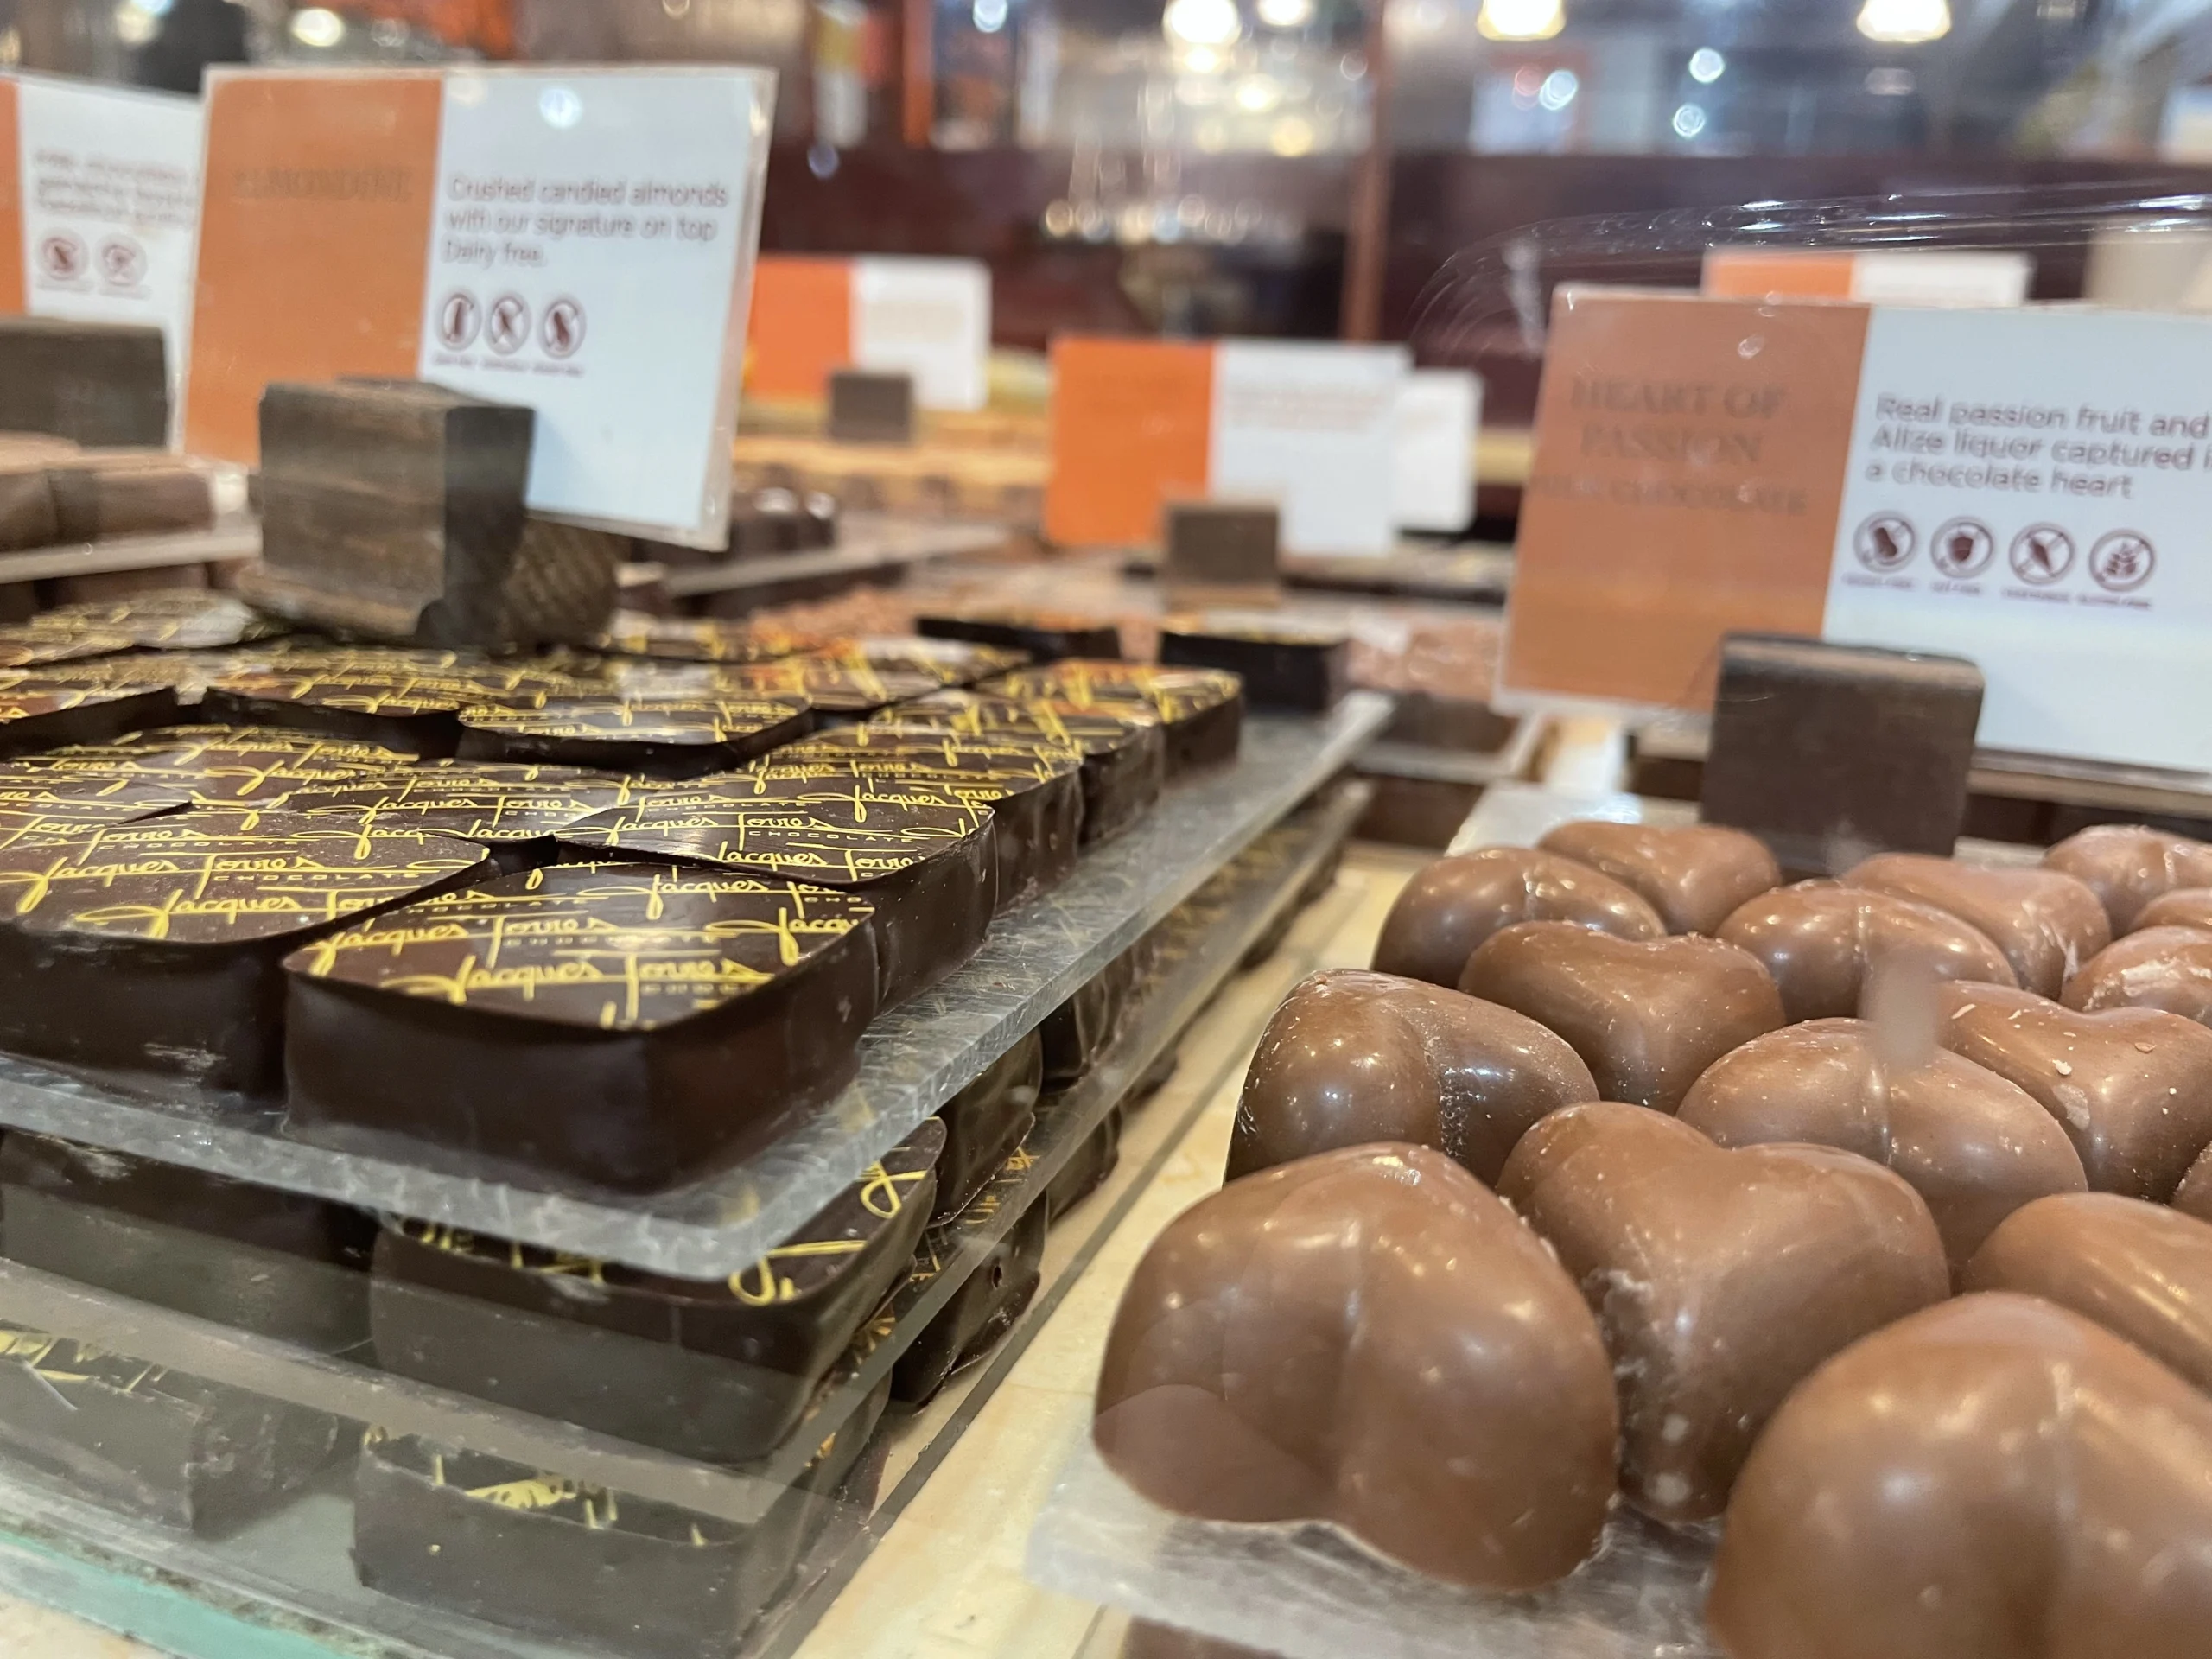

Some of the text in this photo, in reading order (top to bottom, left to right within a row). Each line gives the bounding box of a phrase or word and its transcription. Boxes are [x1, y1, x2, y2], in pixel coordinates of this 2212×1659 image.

[448, 175, 728, 207] Crushed candied almonds
[446, 208, 718, 243] with our signature on top
[442, 238, 494, 268] Dairy
[1570, 378, 1788, 420] HEART OF
[1875, 394, 2210, 441] Real passion fruit and
[1952, 430, 2045, 461] liquor
[2050, 437, 2196, 474] captured
[1865, 461, 2136, 501] a chocolate heart
[302, 796, 454, 827] Jacques
[796, 785, 947, 824] Jacques
[74, 821, 214, 867] Torres
[95, 837, 299, 852] CHOCOLATE
[553, 811, 836, 852] Jacques Torres
[747, 830, 914, 843] CHOCOLATE
[677, 840, 834, 872] Jacques
[0, 849, 327, 914] Jacques Torres
[212, 872, 422, 882] CHOCOLATE
[576, 874, 769, 920] Jacques
[74, 888, 304, 940] Jacques
[301, 911, 622, 977] Jacques Torres
[380, 954, 605, 1006] Jacques
[550, 949, 777, 1022] Torres
